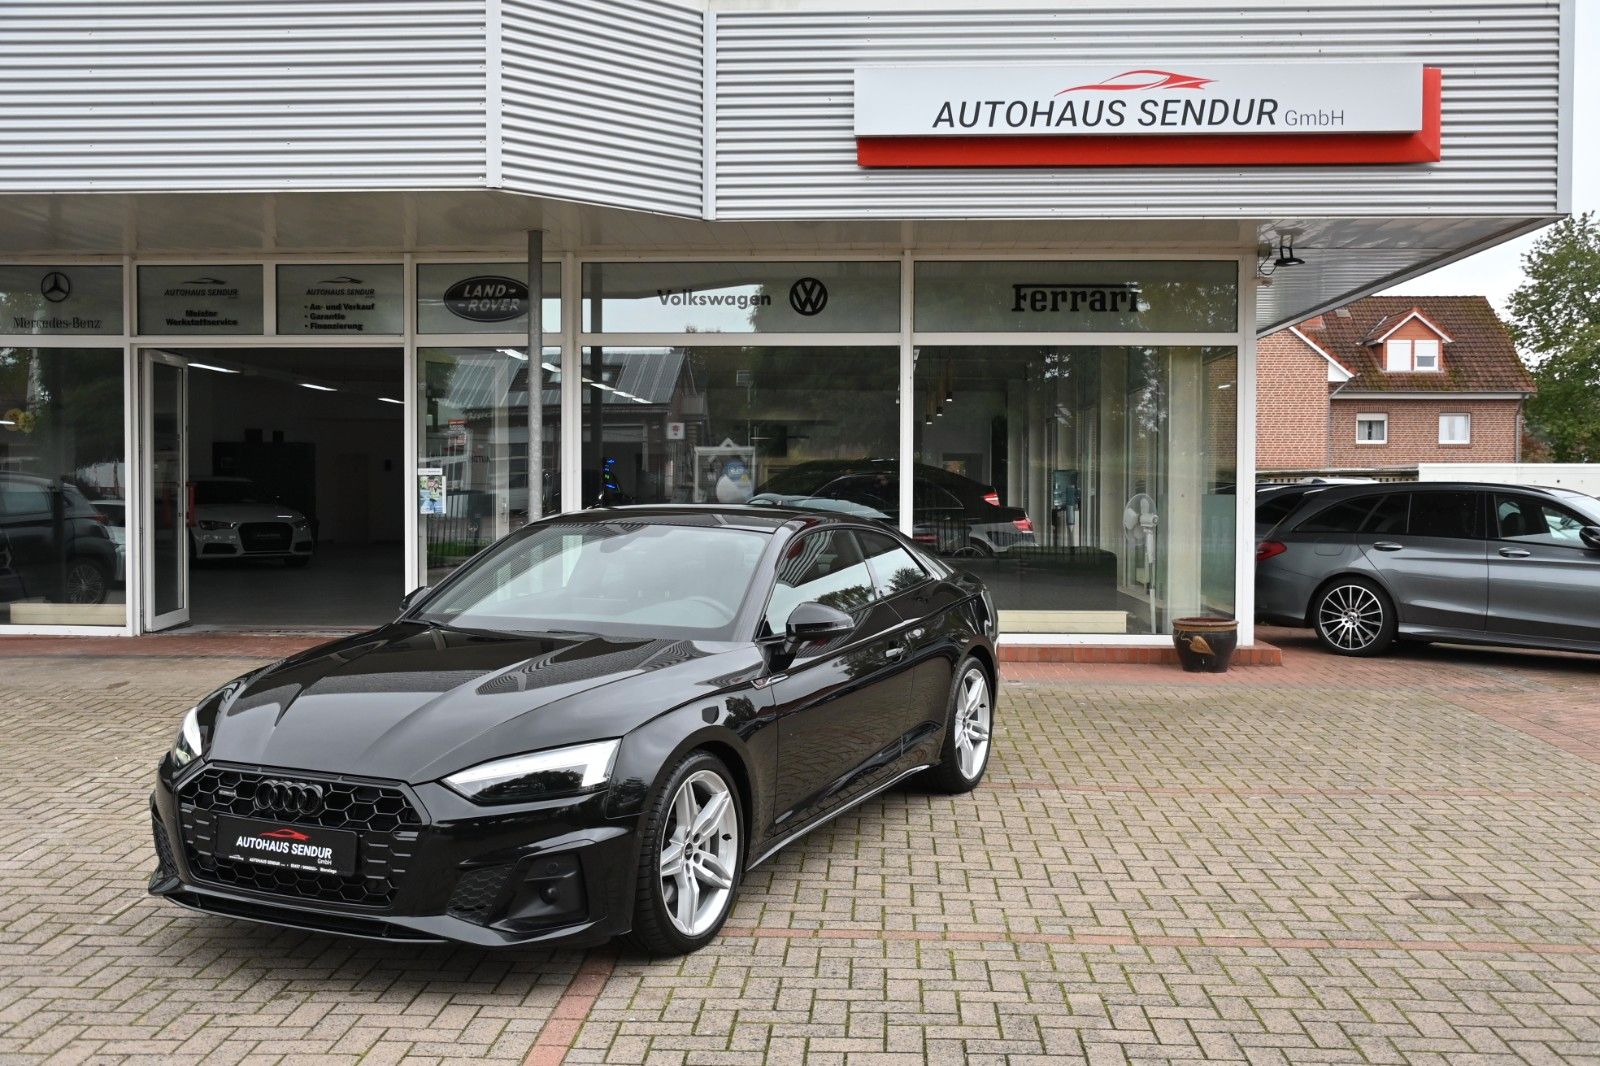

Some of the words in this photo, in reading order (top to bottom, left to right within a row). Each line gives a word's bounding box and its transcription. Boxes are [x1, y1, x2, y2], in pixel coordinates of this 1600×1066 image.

[932, 99, 1127, 128] AUTOHAUS
[1137, 98, 1279, 126] SENDUR
[1285, 109, 1344, 126] GmbH
[164, 288, 206, 297] AUTOHAUS
[207, 288, 238, 297] SENDUR
[306, 288, 345, 296] AUTOHAUS
[346, 288, 375, 296] SENDUR
[657, 289, 772, 310] Volkswagen
[1011, 284, 1139, 312] Ferrari
[326, 303, 342, 311] und
[343, 303, 375, 311] Verkauf
[185, 309, 218, 317] Meister
[13, 317, 102, 329] Mercedes-Benz
[165, 318, 239, 326] Werkstattservice
[309, 322, 364, 331] Finanzierung
[236, 836, 290, 853] AUTOHAUS
[291, 843, 333, 859] SENDUR
[317, 858, 333, 866] GmbH
